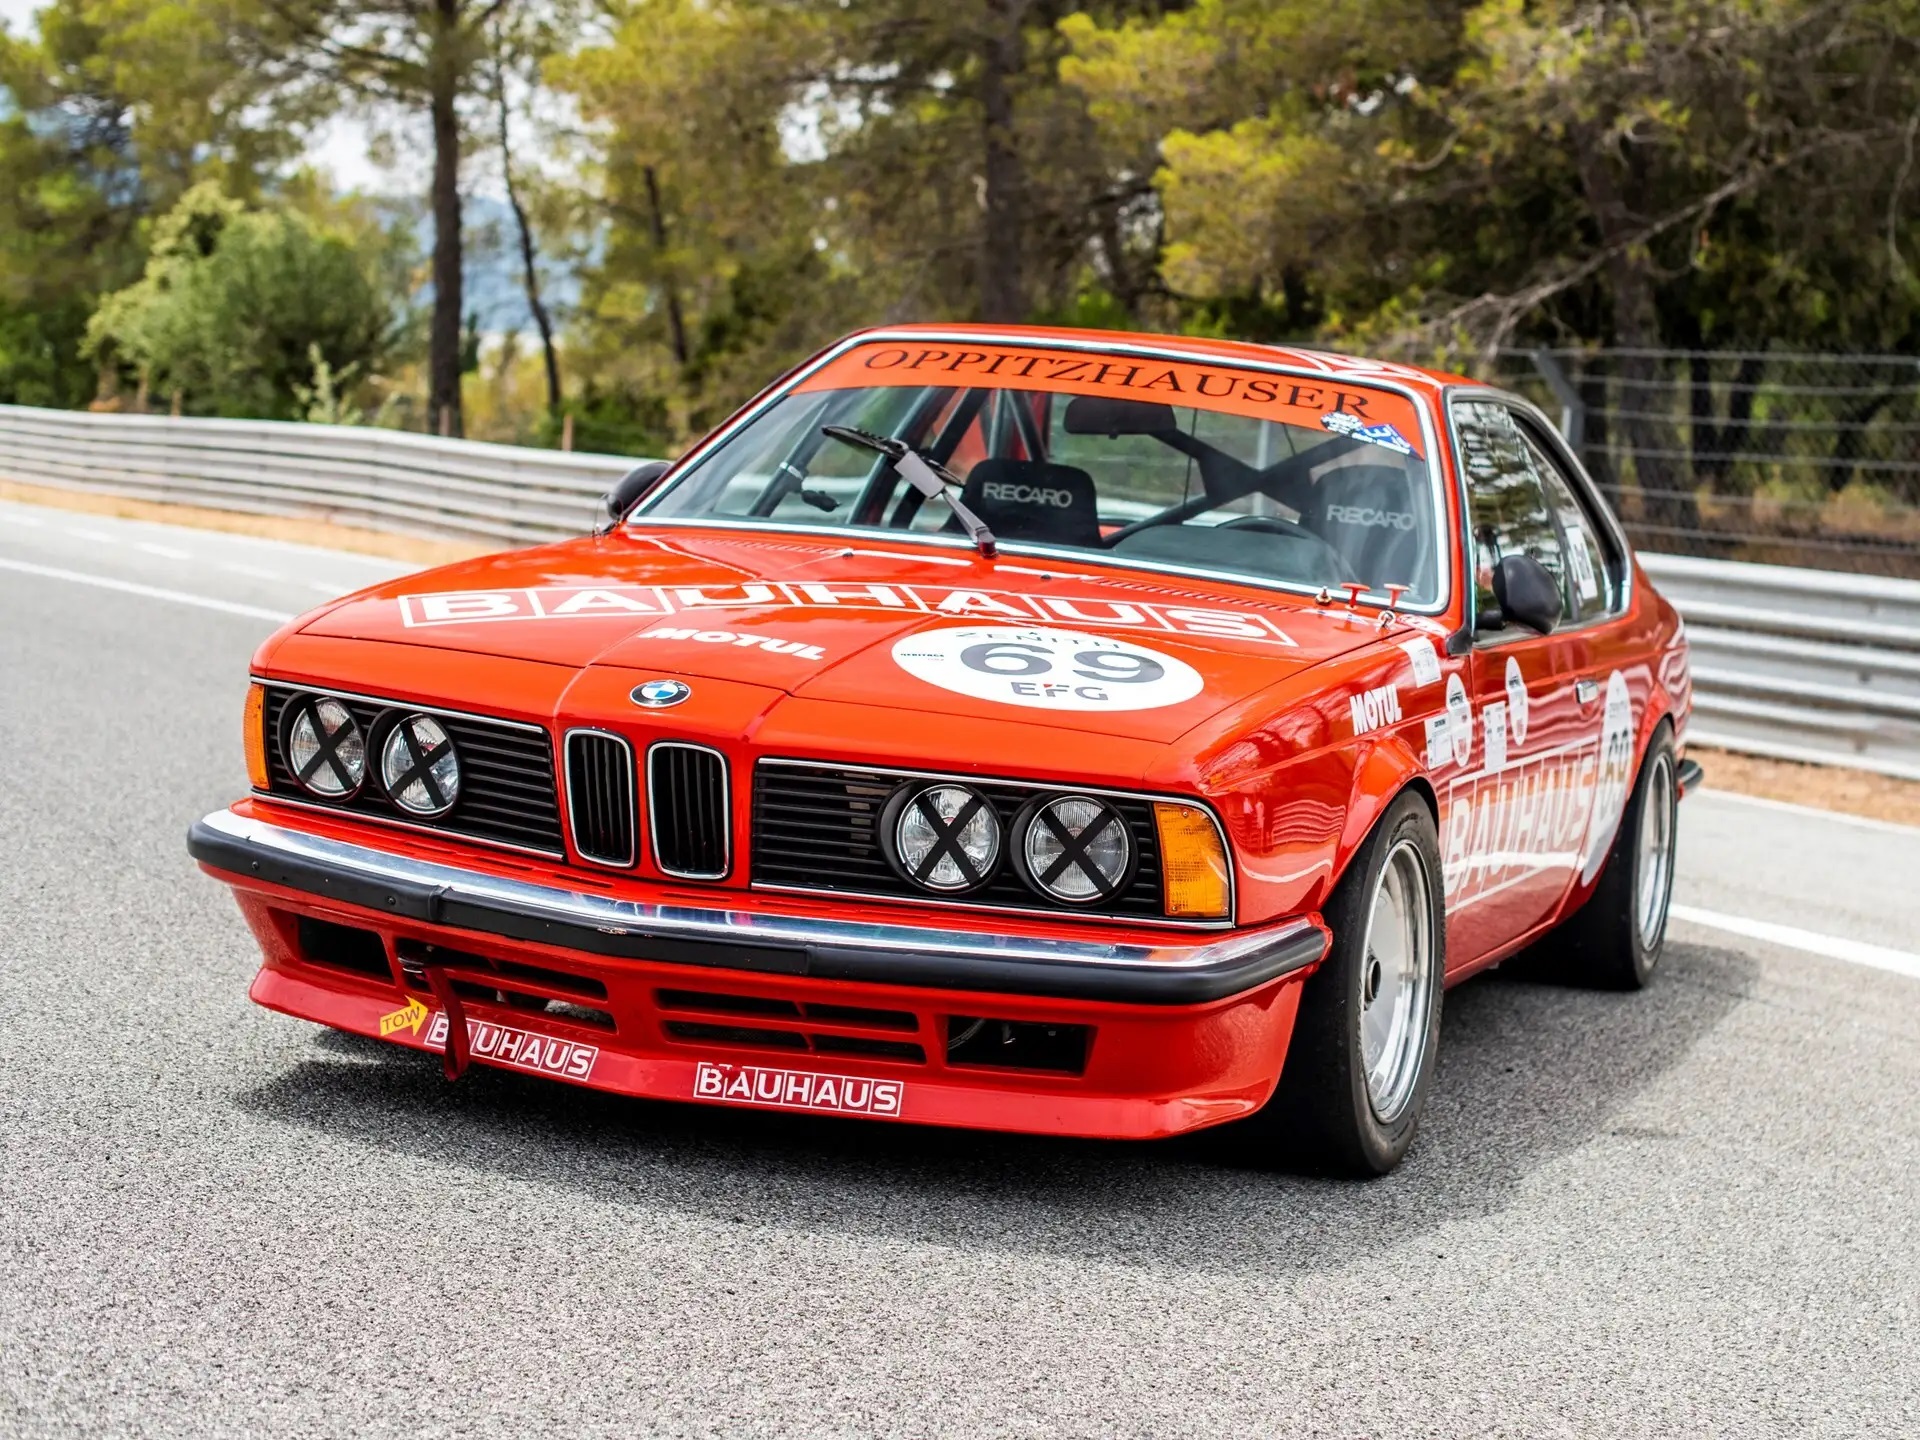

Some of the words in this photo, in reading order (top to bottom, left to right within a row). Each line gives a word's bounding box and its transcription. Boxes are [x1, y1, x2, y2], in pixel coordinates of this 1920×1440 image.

[864, 349, 1376, 421] OPPITZHAUSER
[982, 482, 1073, 508] RECARO
[1326, 504, 1415, 531] RECARO
[421, 582, 1268, 638] BAUHAUS
[638, 627, 826, 660] MOTUL
[960, 643, 1164, 683] 69
[1011, 681, 1109, 701] EFG
[1349, 684, 1402, 736] MOTUL
[1445, 754, 1595, 897] BAUHAUS
[382, 1006, 421, 1032] TOW
[430, 1017, 593, 1075] BUHAUS
[699, 1067, 898, 1111] BAUHAUS
